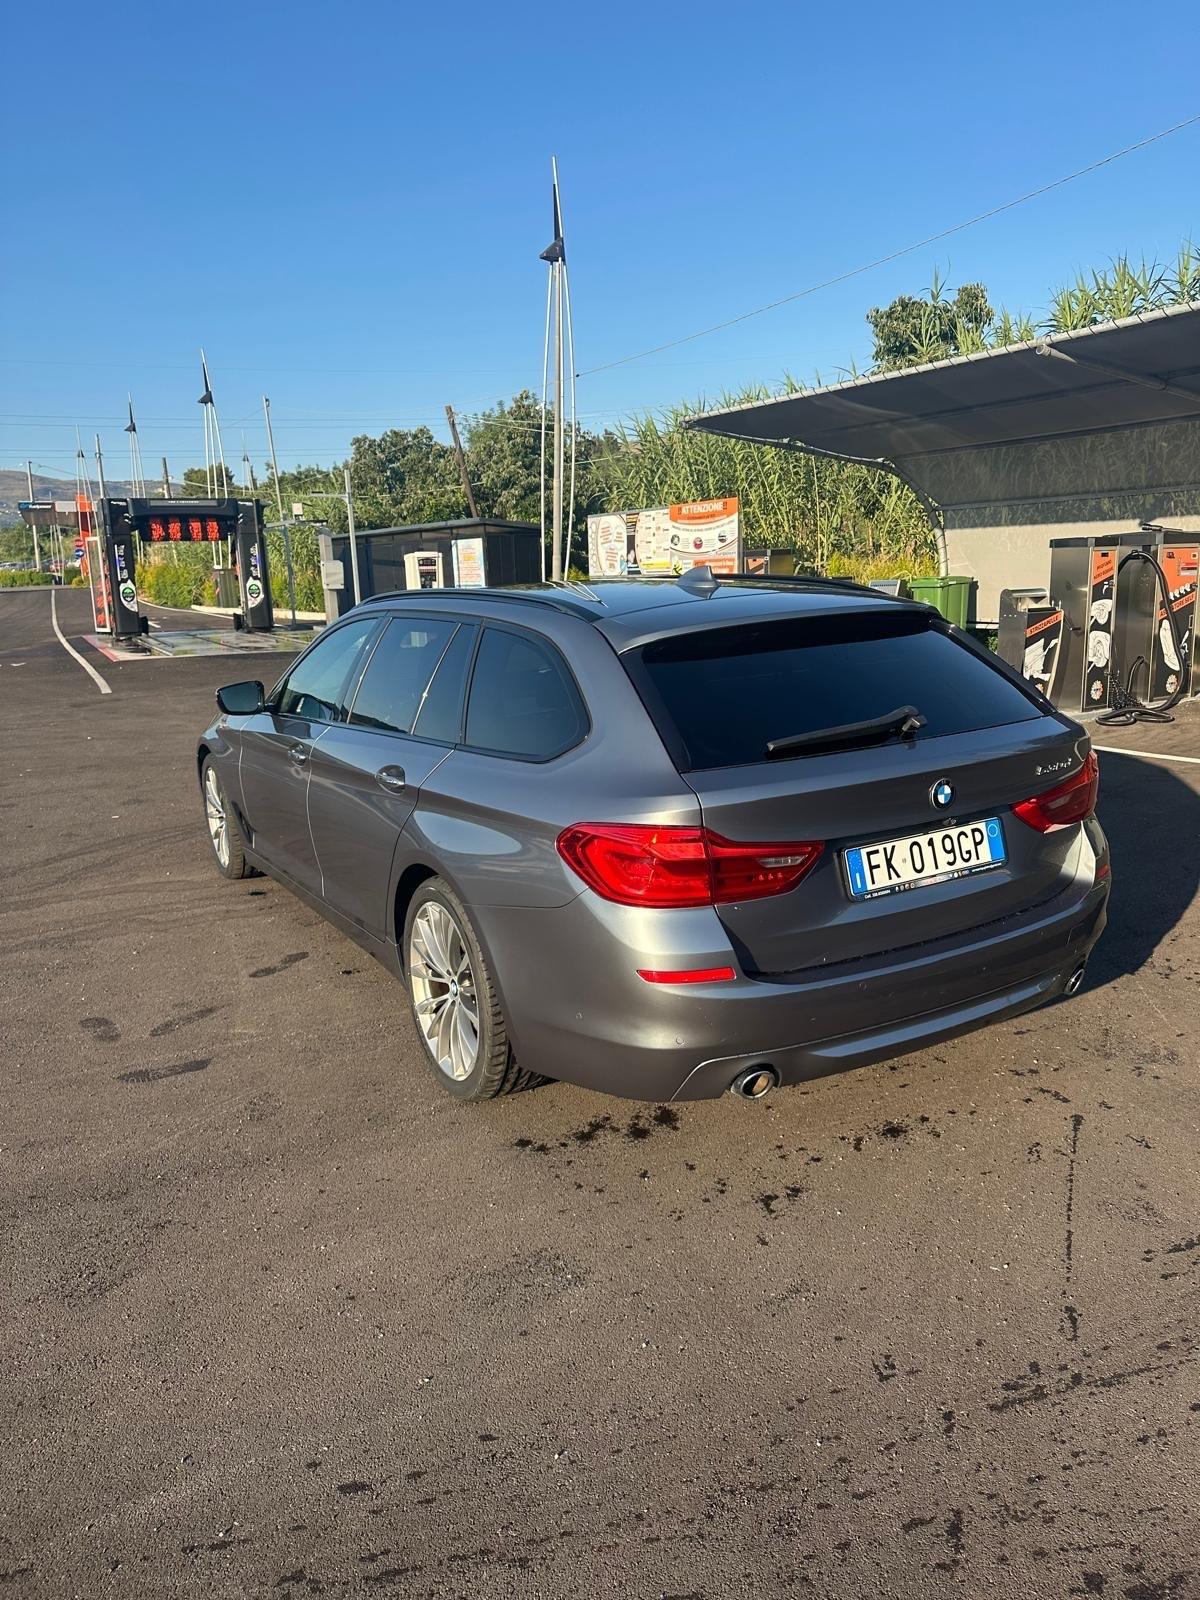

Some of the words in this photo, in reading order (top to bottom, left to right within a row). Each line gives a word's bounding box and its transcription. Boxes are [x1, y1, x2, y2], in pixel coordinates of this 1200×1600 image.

[681, 501, 723, 514] ATTENZIONE
[866, 845, 901, 885] FK
[909, 827, 984, 874] 019GP
